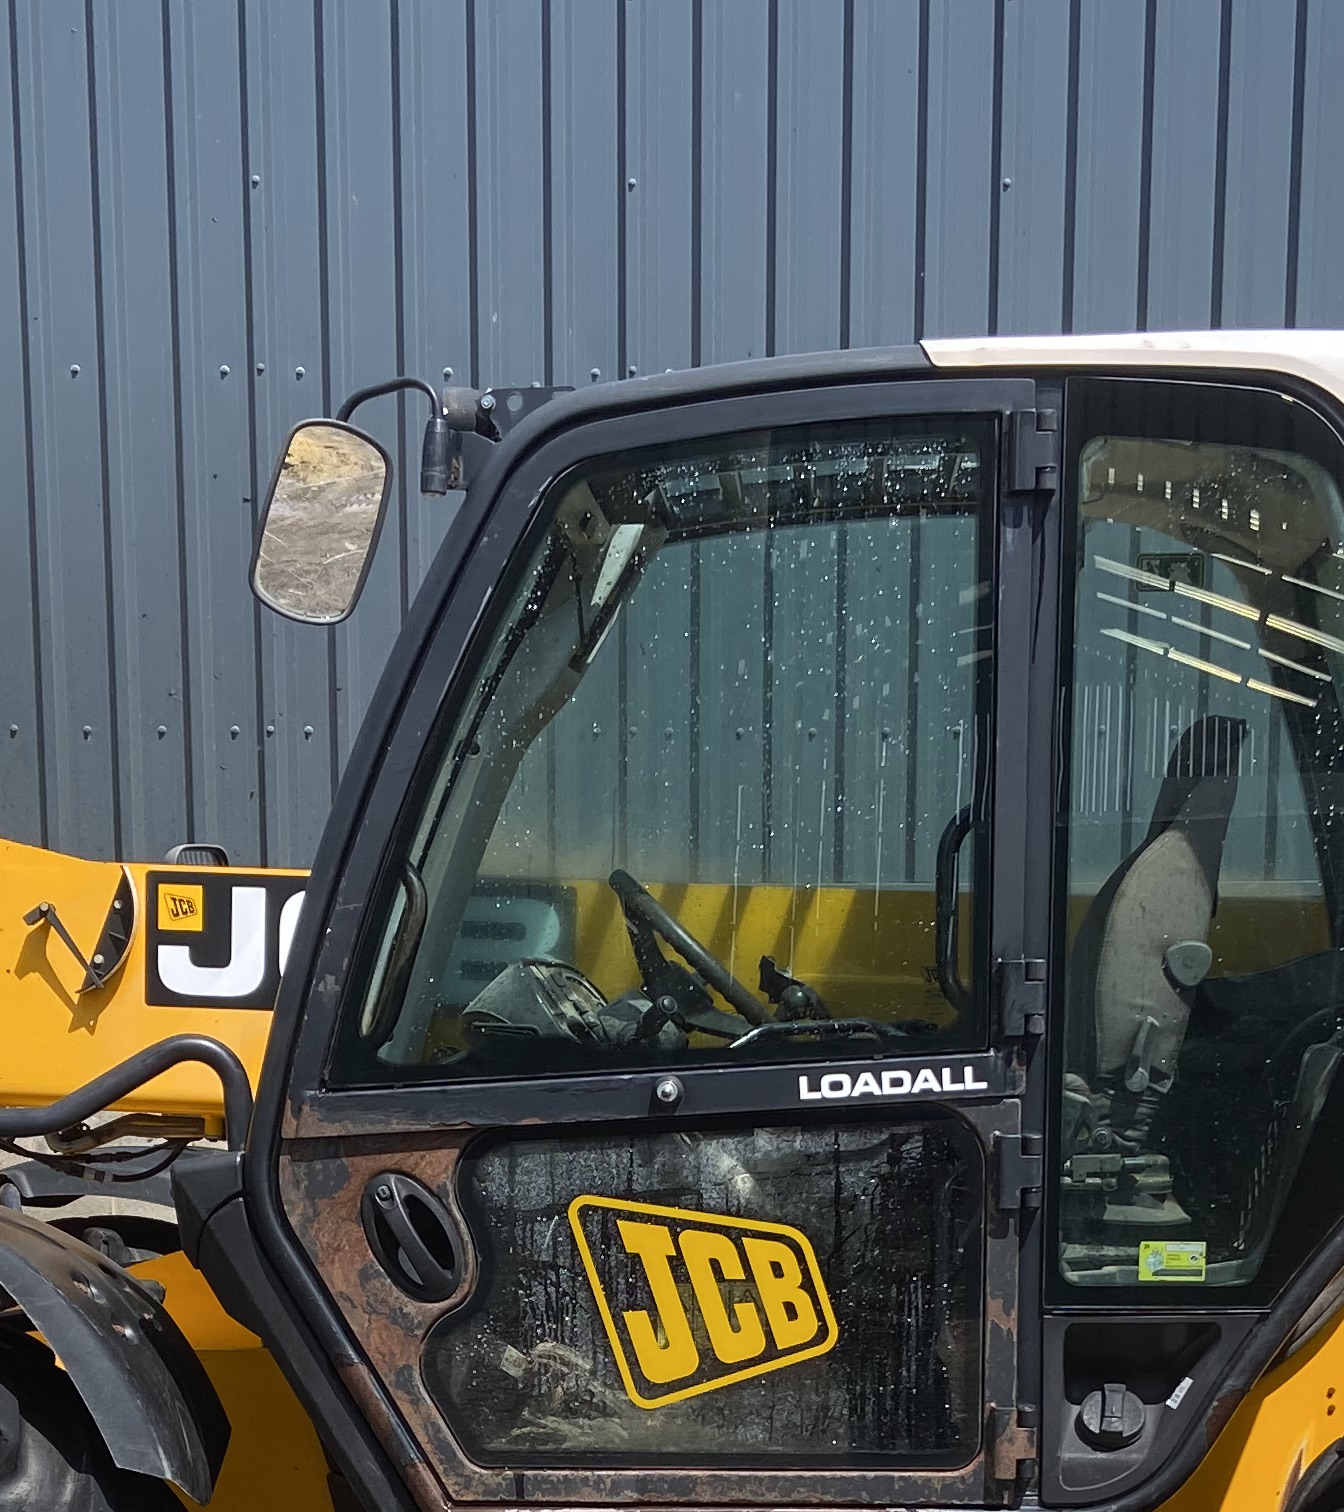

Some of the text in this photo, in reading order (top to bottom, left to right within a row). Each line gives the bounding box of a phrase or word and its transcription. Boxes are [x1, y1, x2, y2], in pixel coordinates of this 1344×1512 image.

[169, 895, 195, 918] JCB
[798, 1066, 988, 1100] LOADALL
[616, 1219, 818, 1384] JCB
